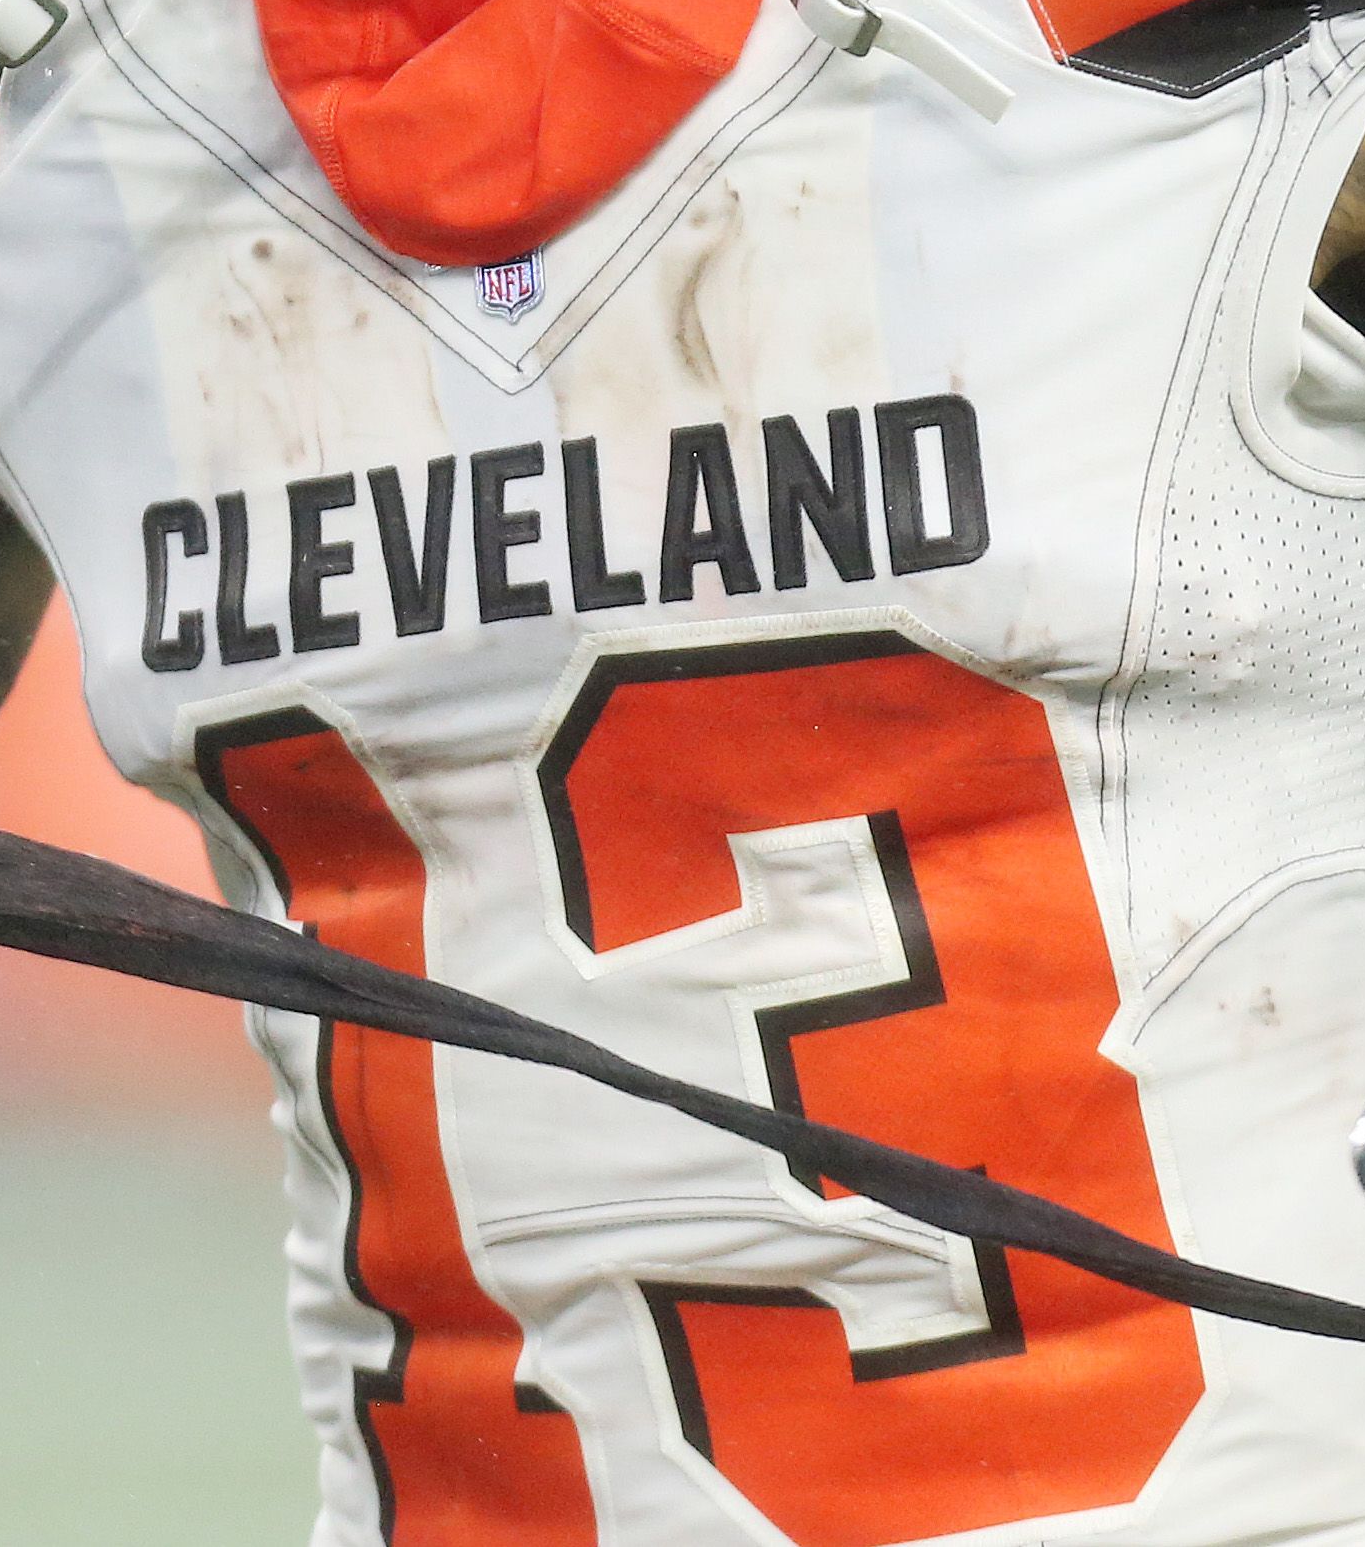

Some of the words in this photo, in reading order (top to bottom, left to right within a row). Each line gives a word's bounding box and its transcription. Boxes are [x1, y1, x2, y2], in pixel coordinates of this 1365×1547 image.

[486, 265, 530, 303] NFL
[140, 392, 991, 673] CLEVELAND
[192, 628, 1209, 1547] 13
